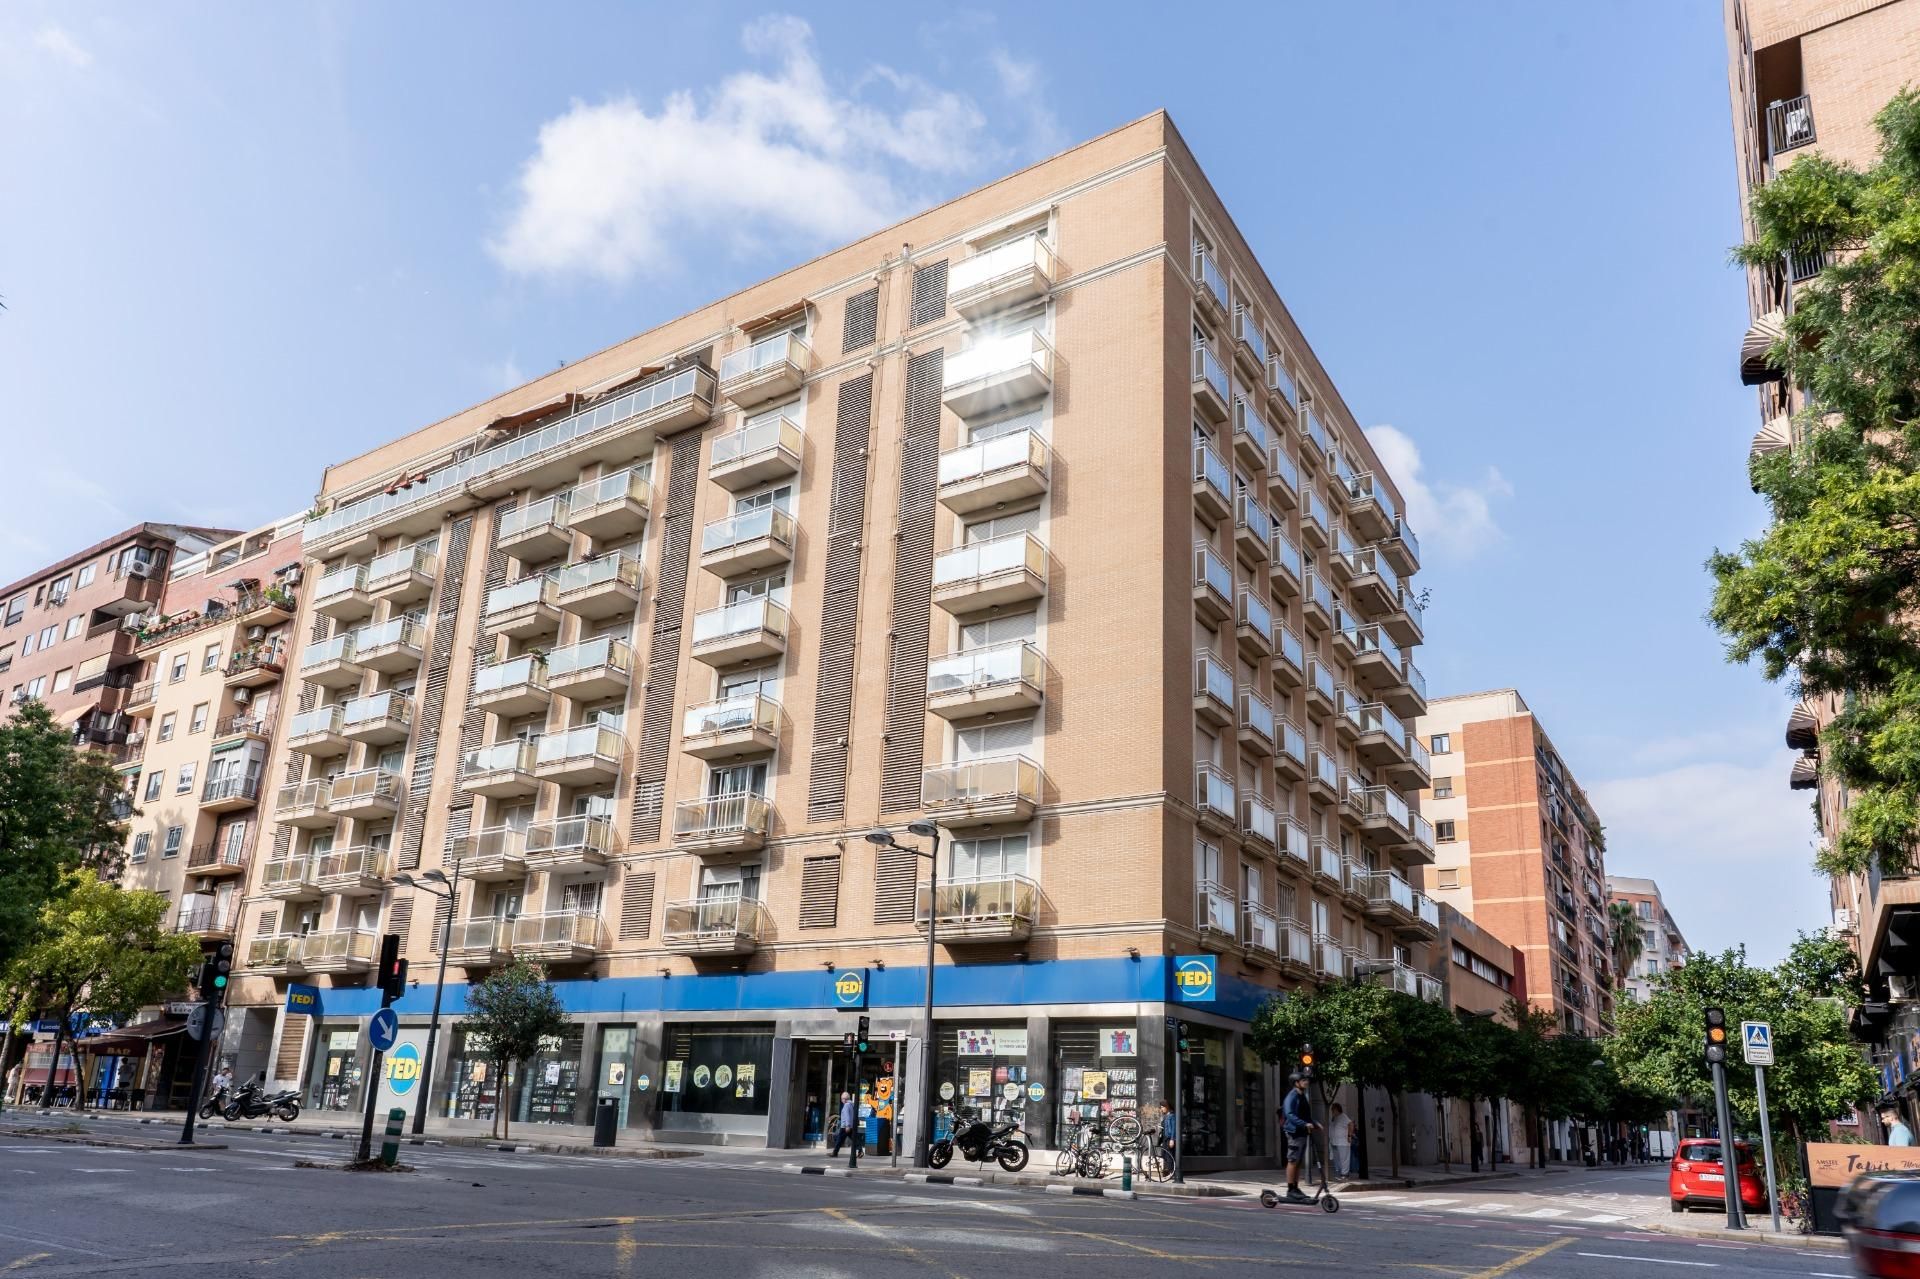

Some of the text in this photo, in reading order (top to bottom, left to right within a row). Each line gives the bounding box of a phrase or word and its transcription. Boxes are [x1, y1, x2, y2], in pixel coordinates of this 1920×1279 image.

[1175, 970, 1212, 986] TEDi
[835, 981, 863, 994] TEDi
[290, 993, 315, 1005] TEDi
[386, 1057, 422, 1080] TEDi
[1027, 1087, 1046, 1096] TEDi
